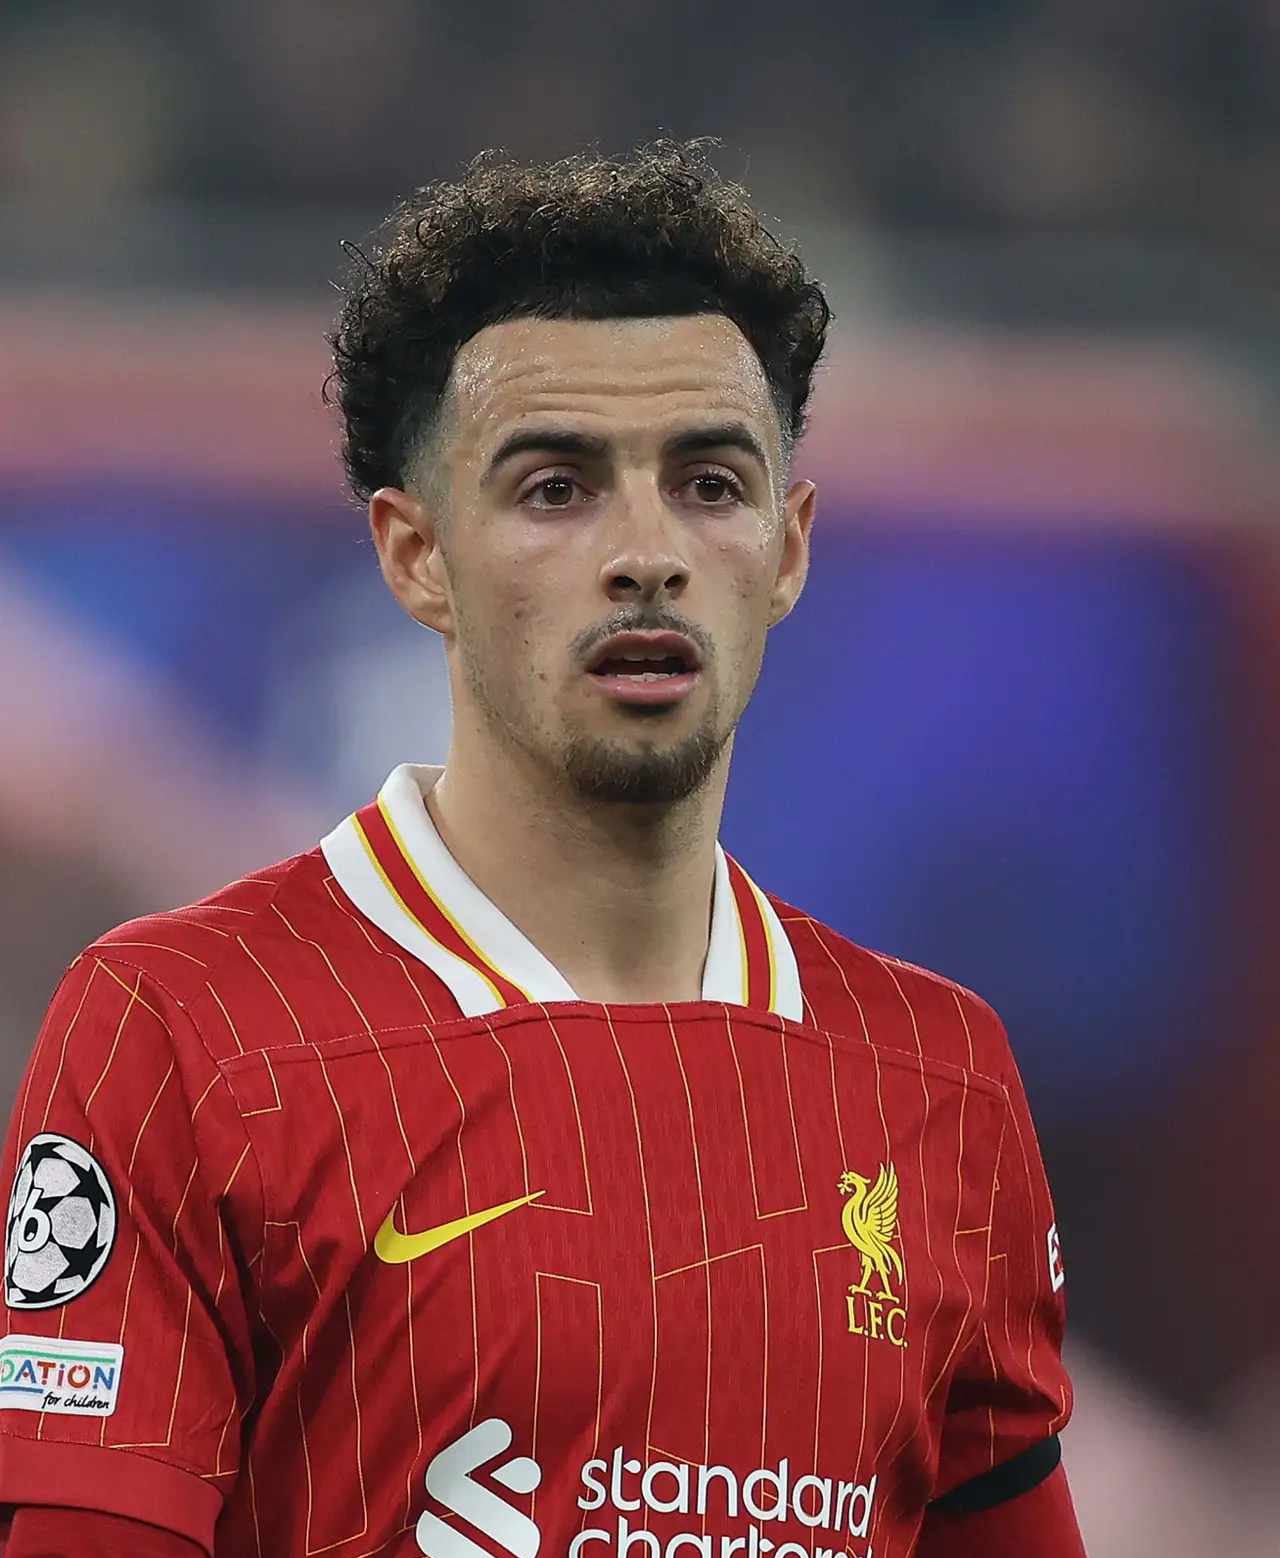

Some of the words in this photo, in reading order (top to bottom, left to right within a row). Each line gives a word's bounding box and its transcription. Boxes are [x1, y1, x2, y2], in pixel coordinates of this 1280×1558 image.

[18, 1187, 52, 1252] 6
[846, 1295, 908, 1348] L.F.C.
[41, 1391, 62, 1409] for
[63, 1394, 110, 1410] children
[577, 1446, 877, 1538] standard
